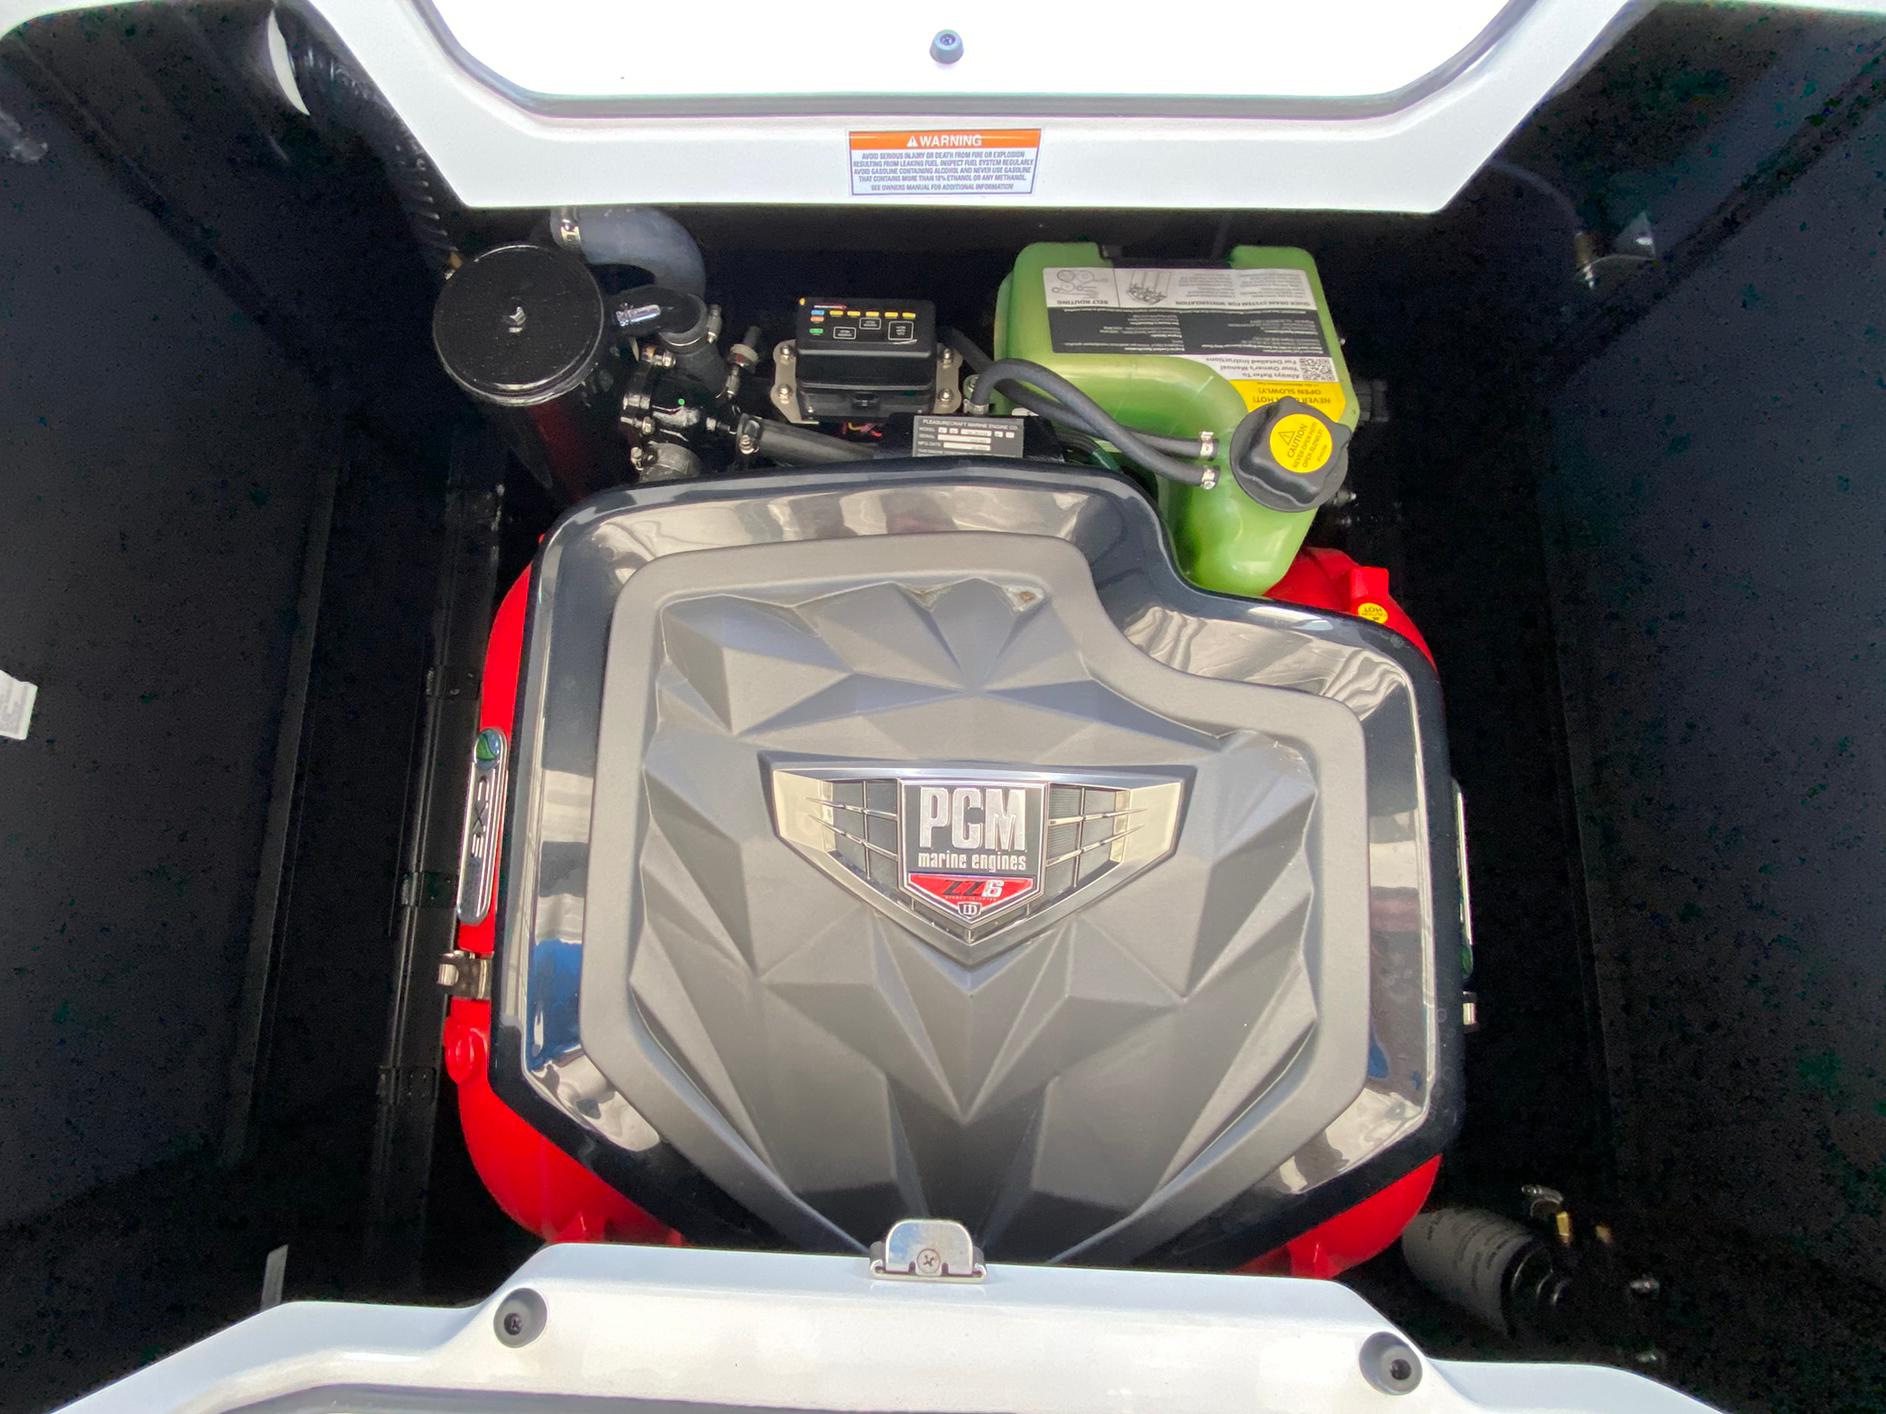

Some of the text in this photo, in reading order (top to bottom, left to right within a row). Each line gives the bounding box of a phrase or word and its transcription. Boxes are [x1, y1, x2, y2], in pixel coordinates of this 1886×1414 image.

[919, 135, 982, 147] WARNING
[1287, 423, 1308, 458] CAUTION
[920, 787, 1026, 850] PCM
[918, 850, 1027, 872] marine engines
[944, 880, 1004, 897] ZZ6
